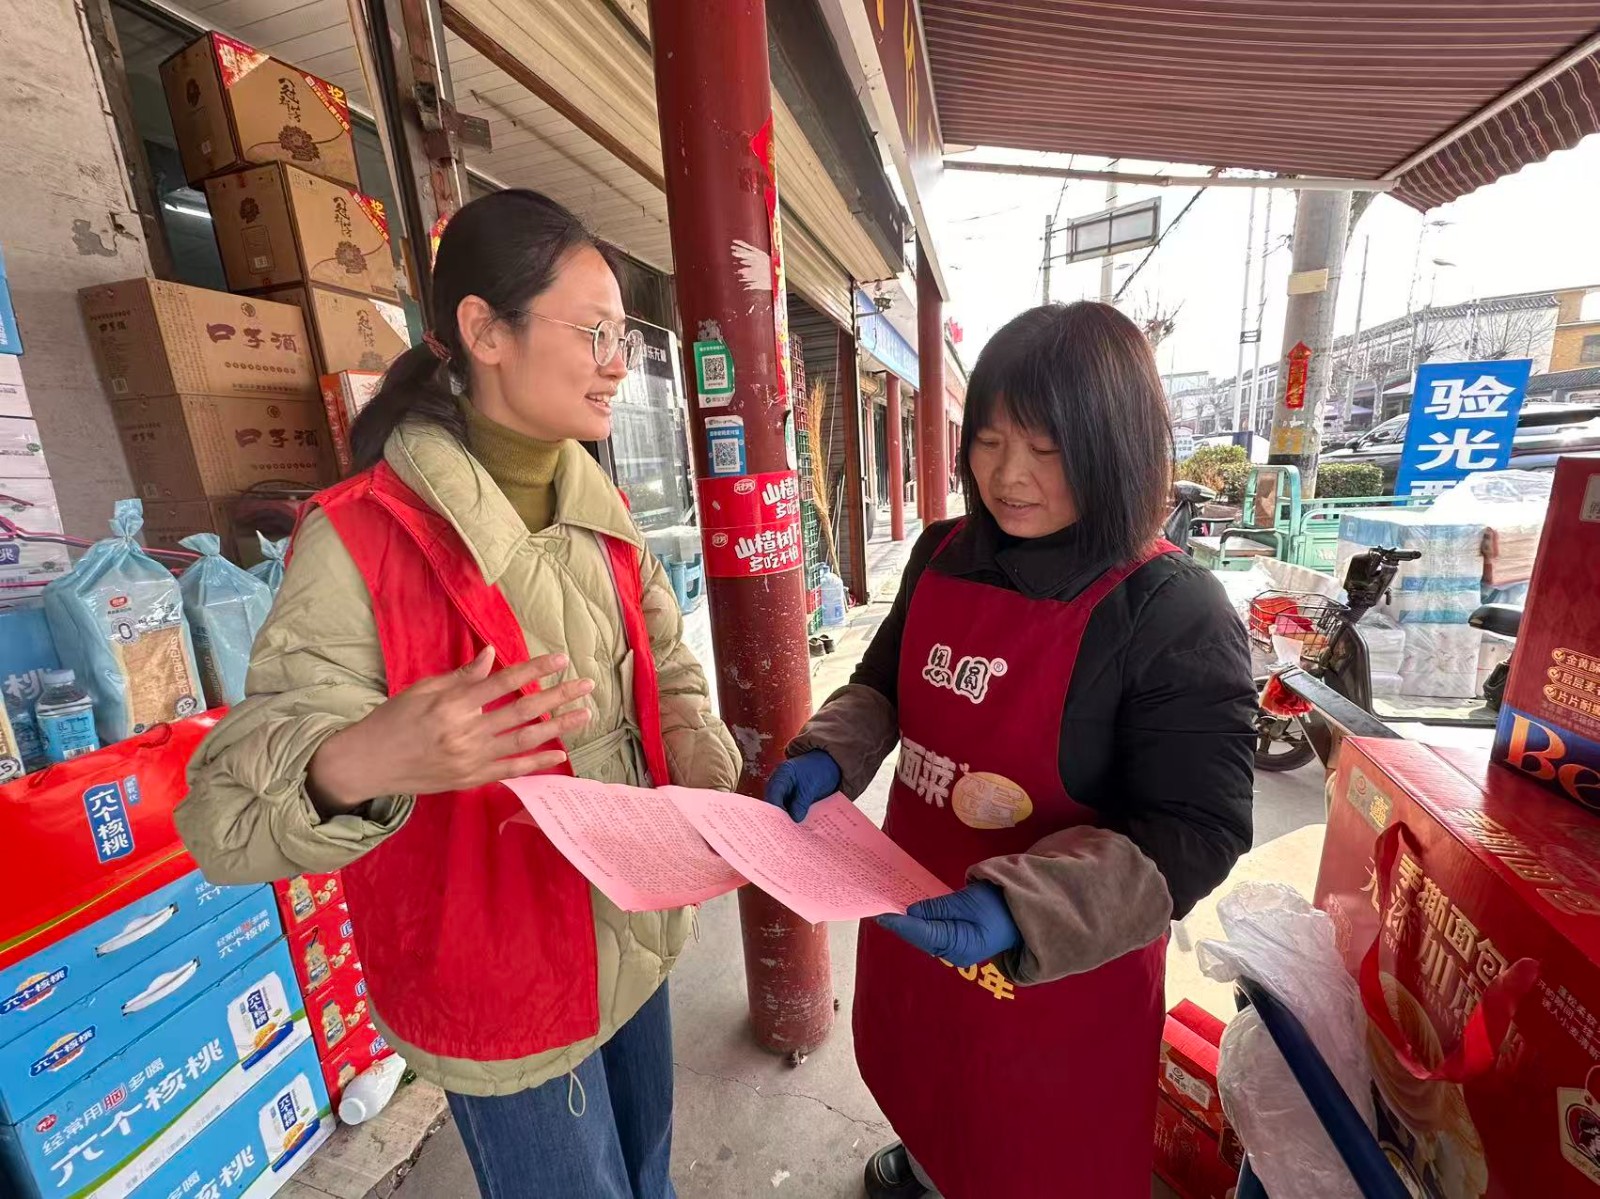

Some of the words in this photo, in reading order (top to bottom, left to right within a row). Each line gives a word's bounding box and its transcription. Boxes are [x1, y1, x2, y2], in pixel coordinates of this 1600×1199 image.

[206, 322, 297, 353] 口子酒
[235, 427, 319, 449] 口子酒
[762, 477, 798, 506] 山楂
[1560, 672, 1600, 697] 层层麦
[179, 699, 192, 713] 25
[88, 788, 130, 856] 六个核桃
[218, 918, 271, 959] 六个核桃
[3, 969, 66, 1012] 六个核桃
[33, 1029, 94, 1073] 六个核桃
[42, 1057, 165, 1157] 经常用脑多喝
[50, 1038, 225, 1188] 六个核桃
